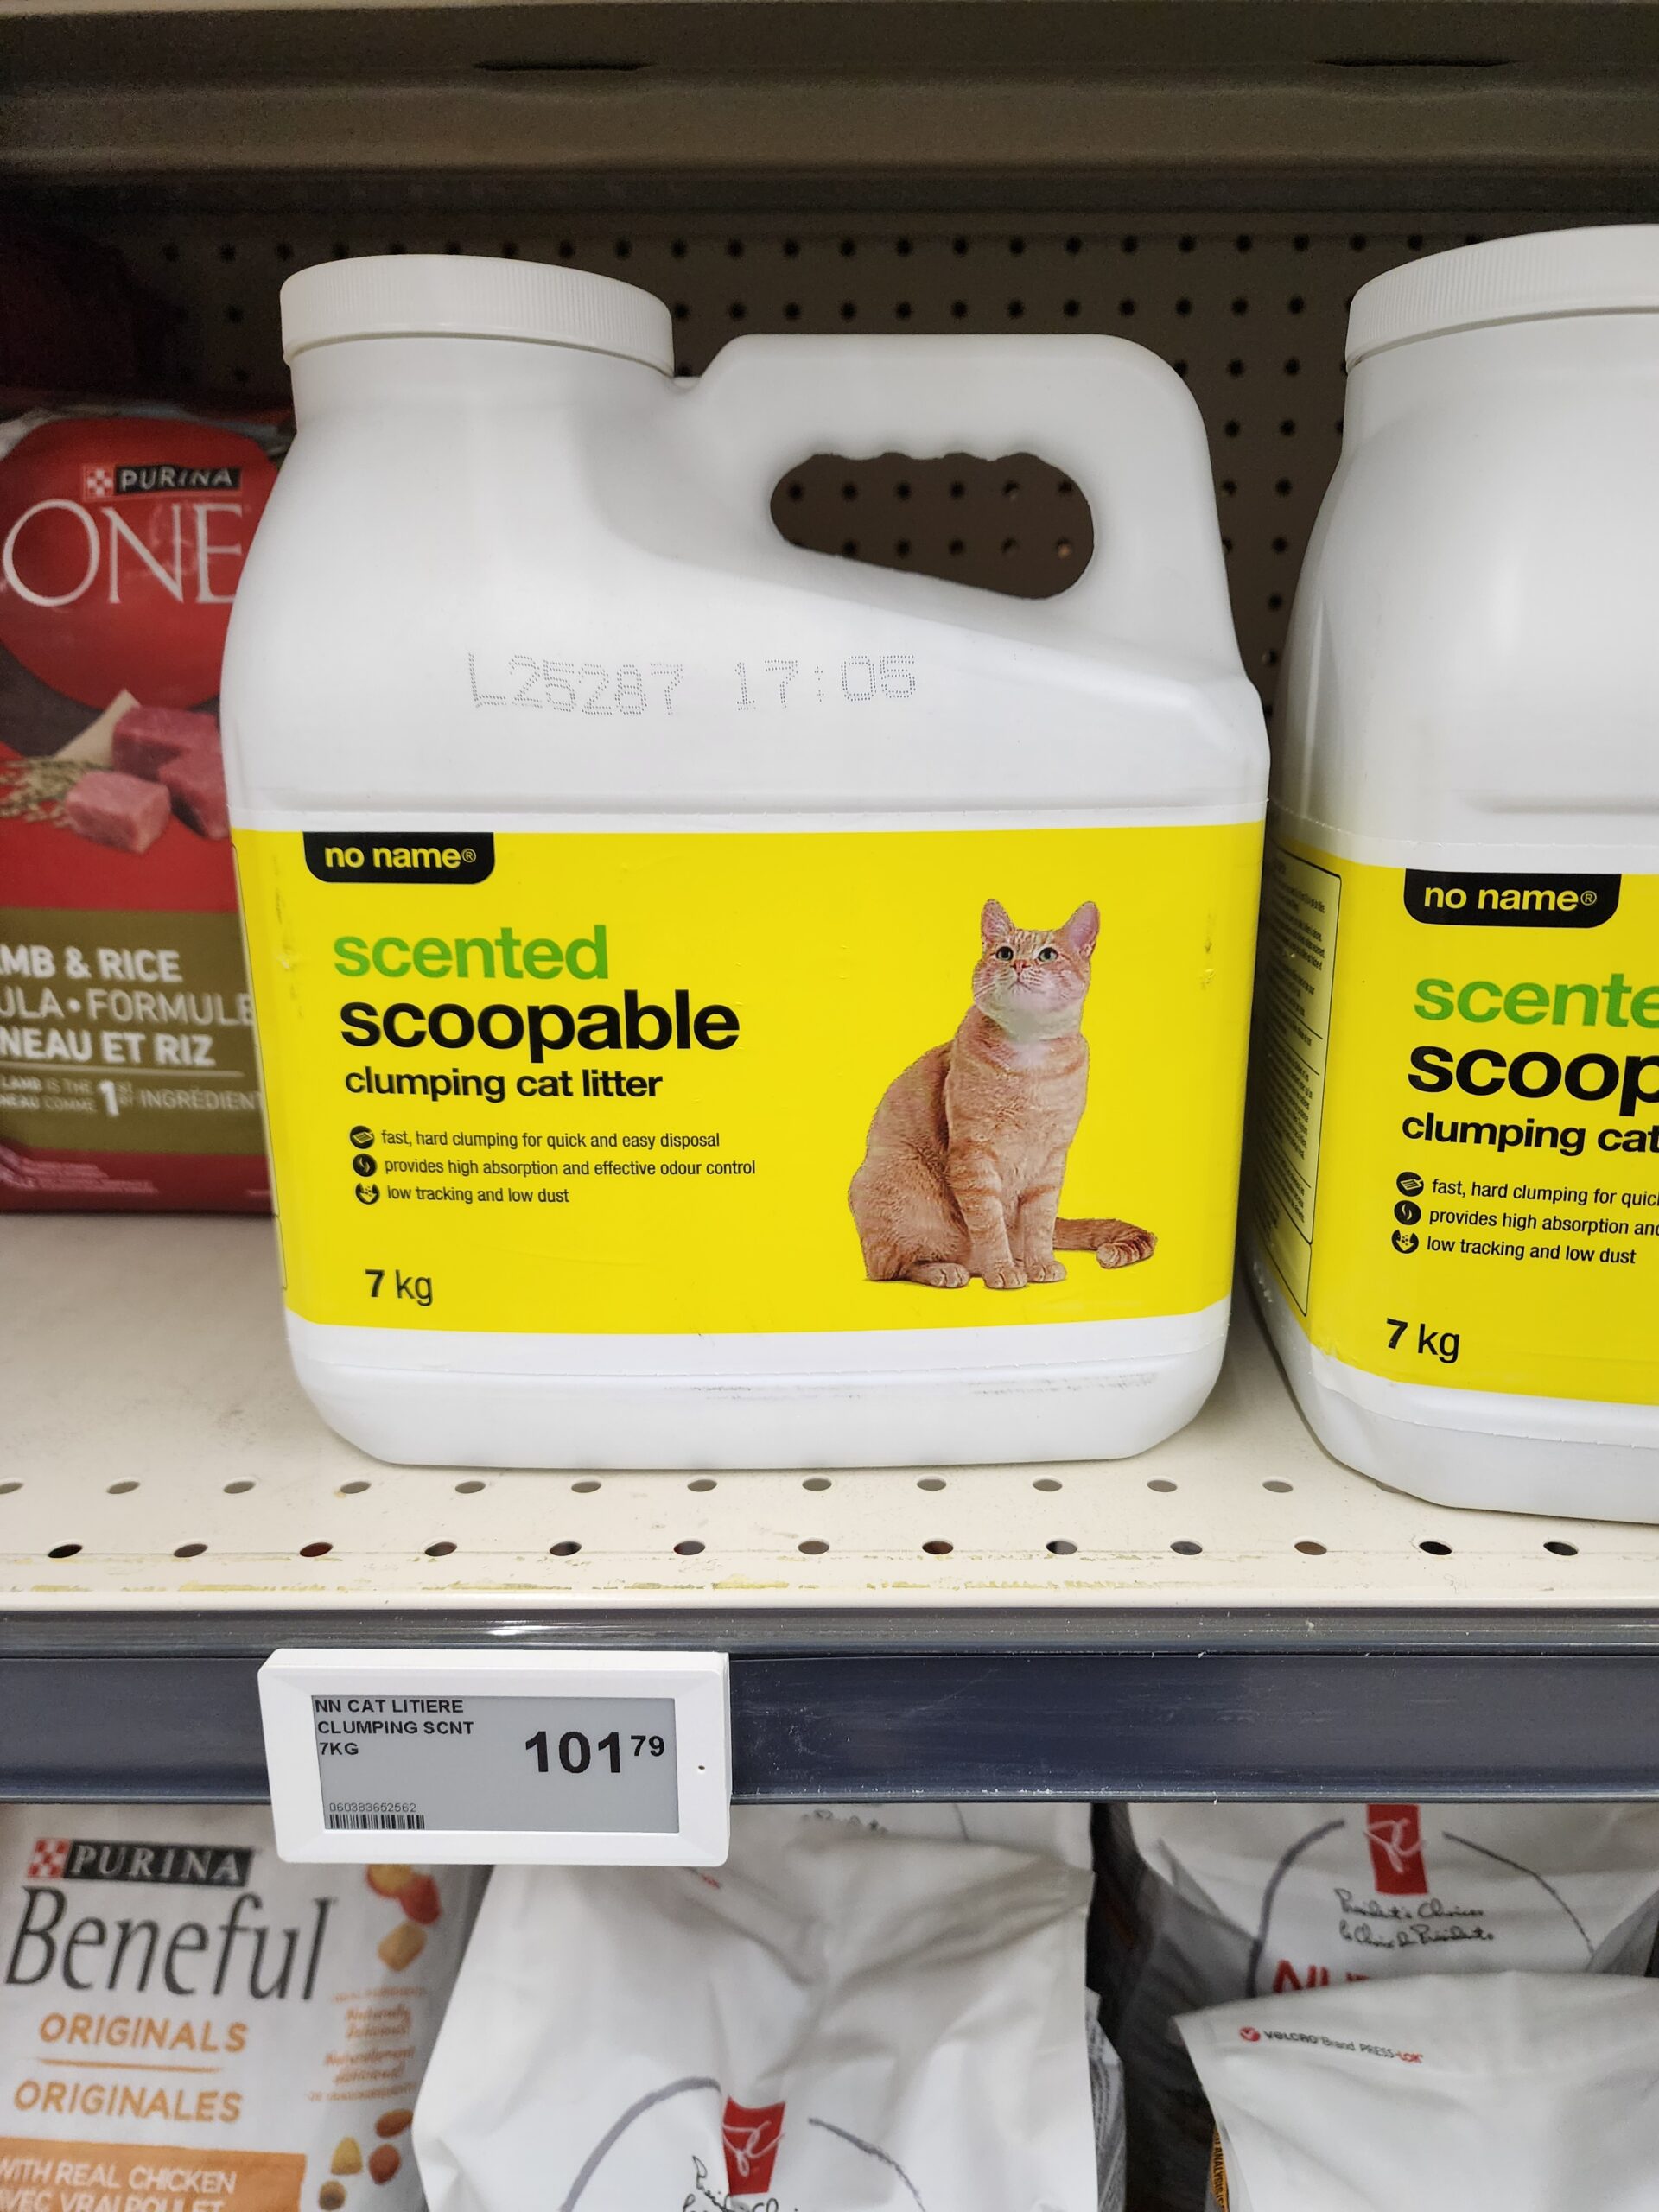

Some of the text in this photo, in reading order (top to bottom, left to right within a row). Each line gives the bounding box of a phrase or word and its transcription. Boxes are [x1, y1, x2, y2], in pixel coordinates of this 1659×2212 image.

[120, 466, 234, 492] PURINA
[3, 499, 242, 607] ONE
[466, 652, 917, 716] L25287 17:05
[324, 846, 364, 868] no
[1424, 887, 1467, 909] no
[65, 945, 92, 979] &
[97, 947, 183, 983] RICE
[334, 924, 609, 980] scented
[1414, 973, 1659, 1029] scente
[339, 988, 741, 1064] scoopable
[99, 1030, 146, 1064] ET
[152, 1033, 217, 1067] RIZ
[345, 1065, 664, 1103] clumping cat litter
[1408, 1046, 1659, 1117] scoop
[381, 1130, 721, 1151] fast, hard clumping for quick and easy disposal
[1402, 1112, 1586, 1157] clumping
[385, 1159, 757, 1178] provides high absorption and effective odour control
[387, 1185, 570, 1205] low tracking and low dust
[1432, 1179, 1659, 1208] fast, hard clumping for quic
[1429, 1209, 1497, 1227] provides
[1502, 1211, 1537, 1232] high
[1541, 1215, 1629, 1236] absorption
[1427, 1236, 1637, 1264] low tracking and low dust
[365, 1269, 434, 1307] 7 kg
[1386, 1318, 1460, 1364] 7 kg
[315, 1699, 464, 1714] NN CAT LITIERE
[317, 1720, 474, 1735] CLUMPING SCNT
[319, 1742, 359, 1757] 7KG
[72, 1844, 244, 1884] PURINA
[5, 1885, 339, 2001] Beneful
[39, 2012, 249, 2053] ORIGINALS
[14, 2079, 244, 2124] ORIGINALES
[55, 2160, 122, 2189] REAL
[129, 2165, 238, 2195] CHICKEN
